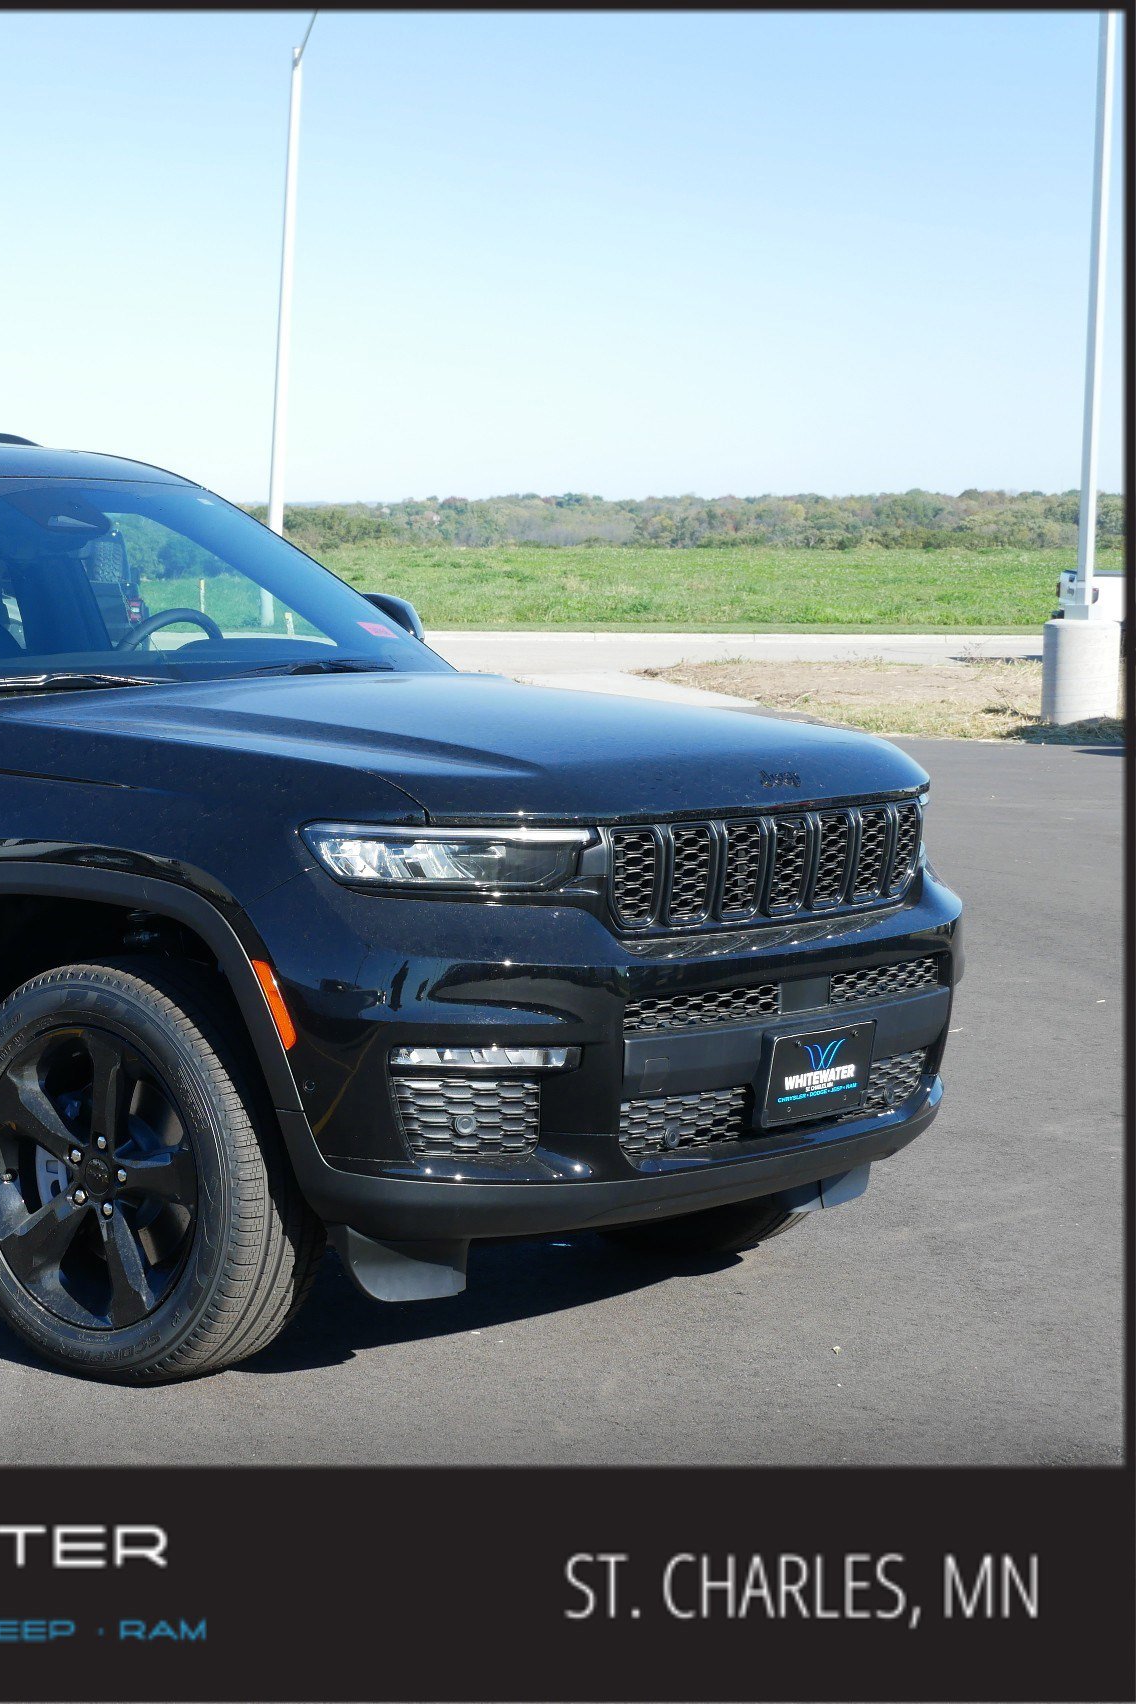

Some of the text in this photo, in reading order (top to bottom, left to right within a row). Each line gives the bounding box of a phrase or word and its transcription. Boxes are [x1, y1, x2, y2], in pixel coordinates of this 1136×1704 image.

[784, 1063, 856, 1091] WHITEWATER
[777, 1093, 807, 1103] CHRYSLER
[809, 1088, 828, 1098] DODGE
[845, 1082, 858, 1090] RAM
